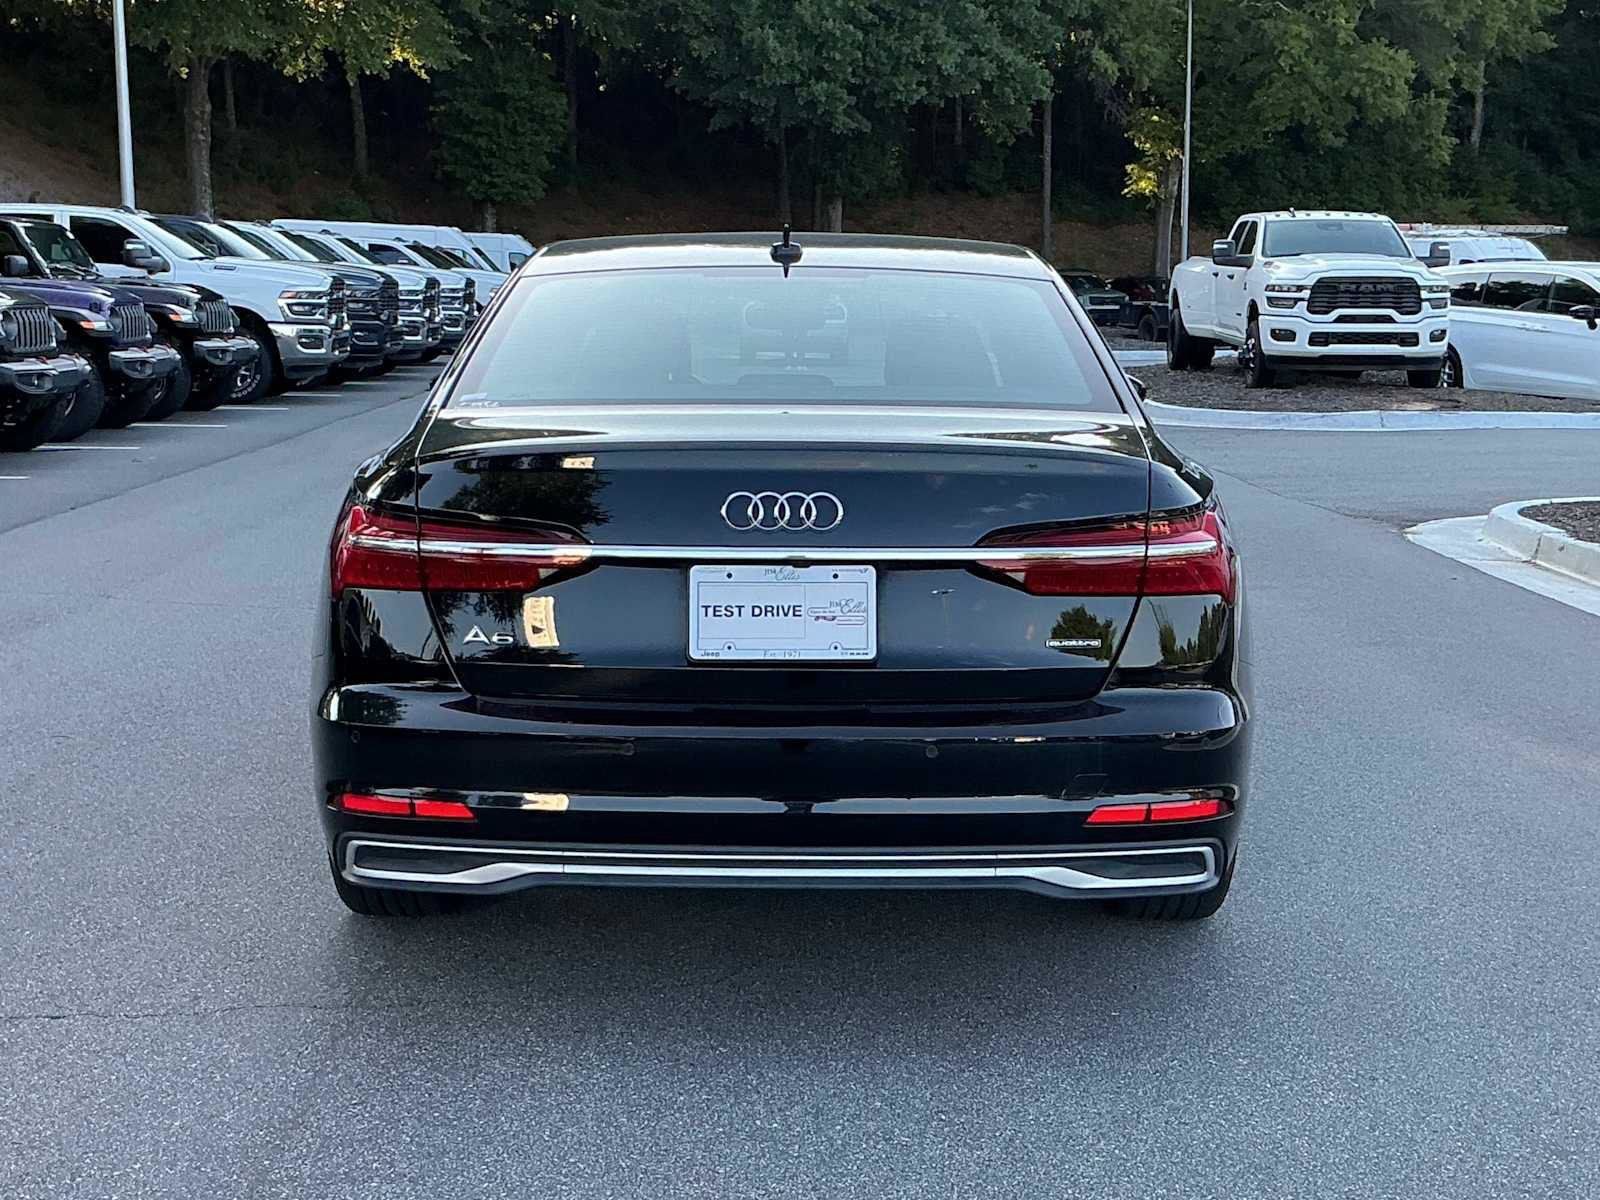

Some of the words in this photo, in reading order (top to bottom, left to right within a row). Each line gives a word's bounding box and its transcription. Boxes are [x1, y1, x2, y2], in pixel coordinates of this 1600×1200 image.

[1338, 284, 1396, 294] RAM
[701, 605, 745, 617] TEST
[751, 605, 803, 617] DRIVE
[463, 625, 514, 645] A6
